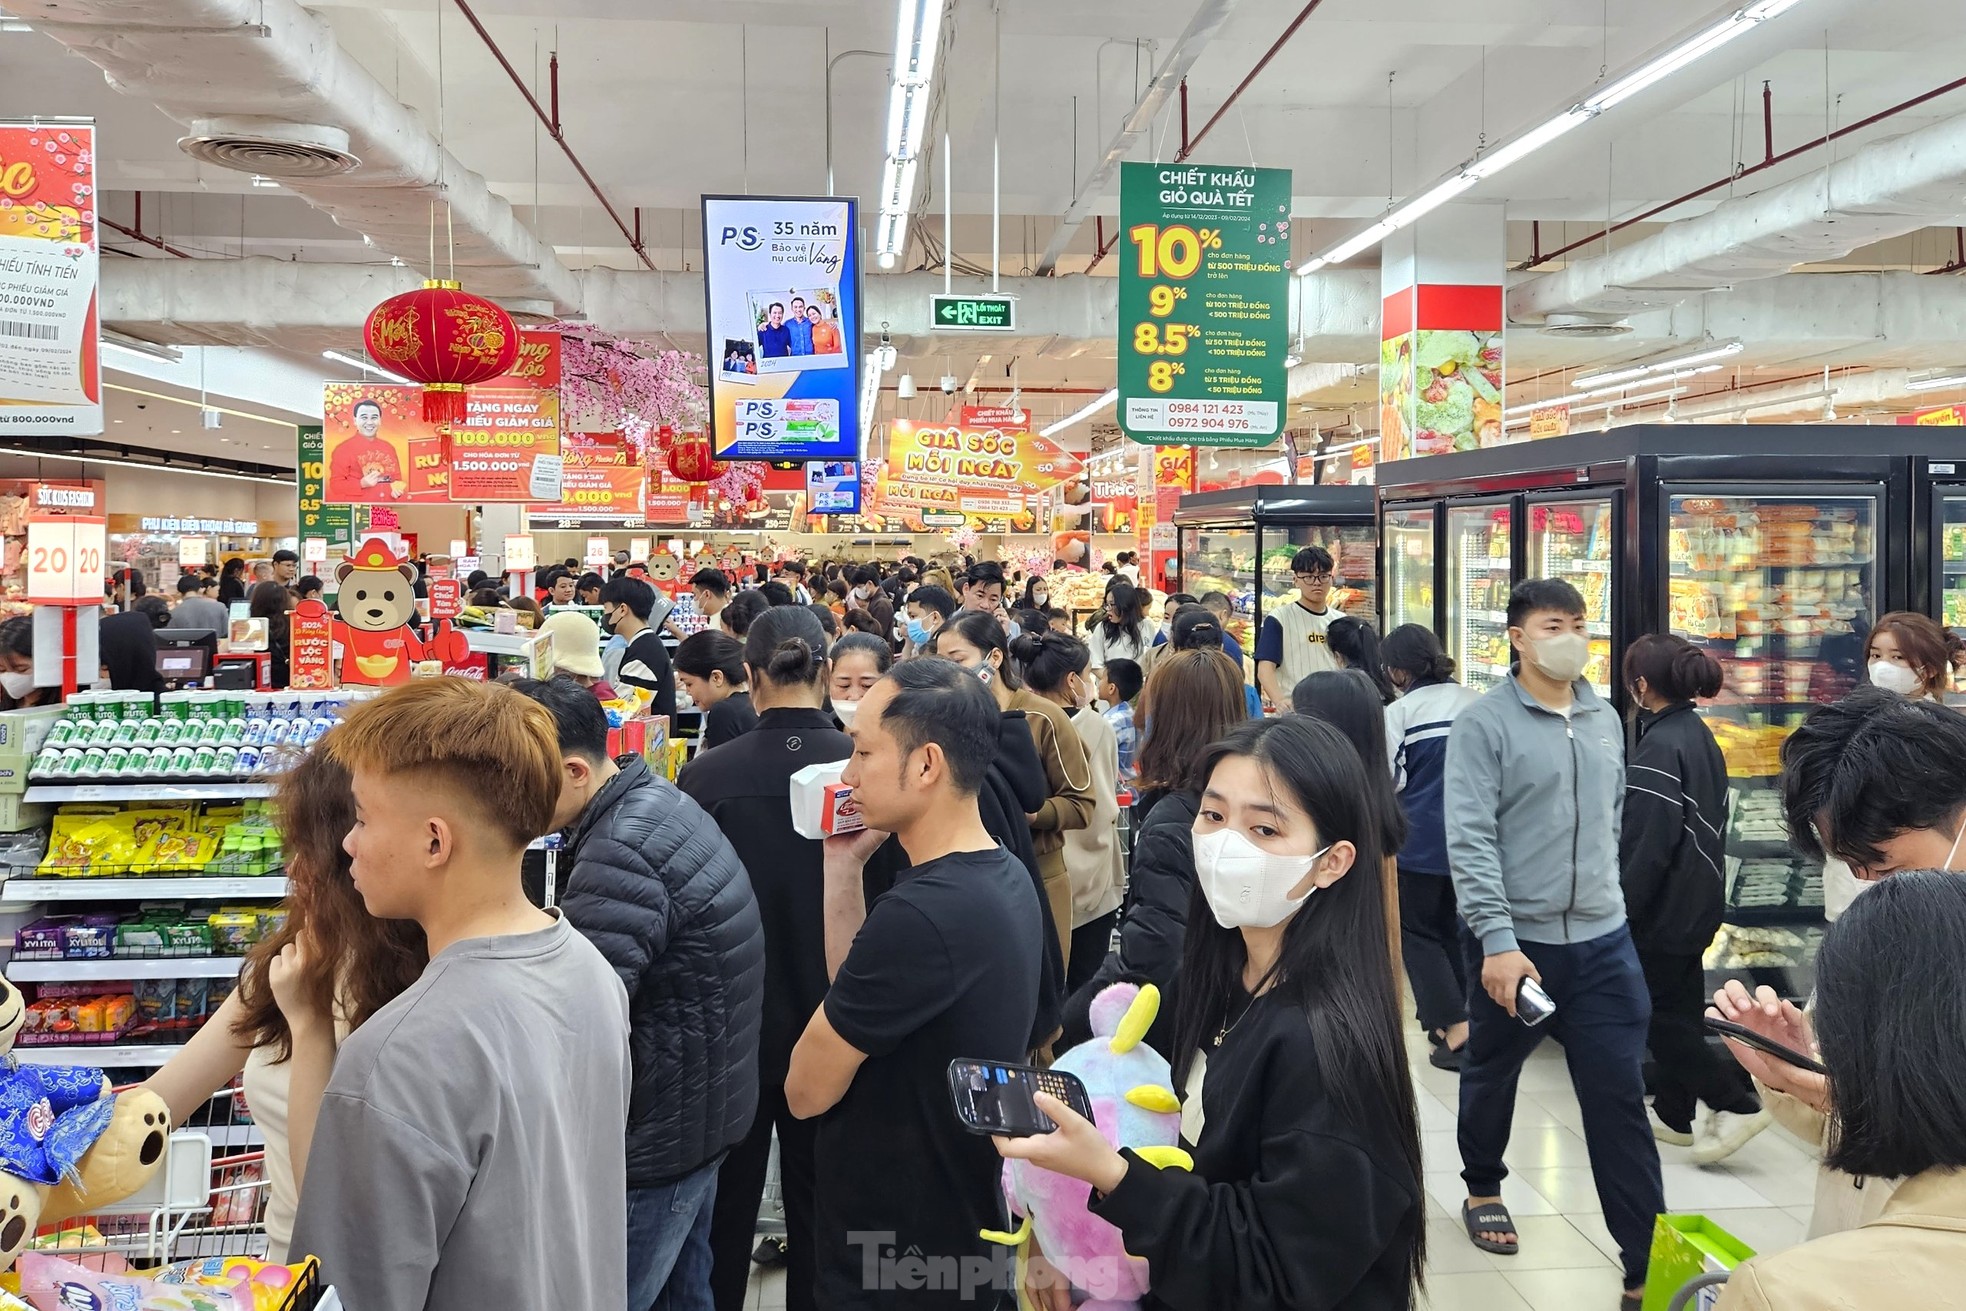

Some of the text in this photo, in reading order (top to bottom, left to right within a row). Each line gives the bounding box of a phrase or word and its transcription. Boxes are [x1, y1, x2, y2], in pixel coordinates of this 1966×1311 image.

[1160, 168, 1255, 187] CHIẾT KHẤU
[1160, 186, 1254, 206] GIỎ QUÀ TẾT
[774, 221, 837, 235] 35 năm
[772, 241, 841, 274] Bảo vệ Vàng
[1130, 224, 1222, 279] 10%
[772, 254, 807, 264] nụ cười
[26, 260, 52, 277] TÍNH
[1233, 262, 1257, 272] TRIỆU
[1257, 262, 1281, 272] ĐỒNG
[8, 282, 32, 293] PHIẾU
[34, 284, 54, 296] GIẢM
[55, 287, 69, 297] GIÁ
[0, 294, 54, 308] 00.000VND
[1148, 284, 1187, 317] 9%
[1228, 301, 1248, 309] TRIỆU
[1249, 300, 1270, 309] ĐỒNG
[979, 316, 1003, 324] EXIT
[1228, 310, 1248, 319] TRIỆU
[1249, 310, 1270, 319] ĐỒNG
[1133, 321, 1201, 356] 8.5%
[1224, 338, 1244, 347] TRIỆU
[1245, 338, 1266, 347] ĐỒNG
[1226, 348, 1245, 357] TRIỆU
[1246, 348, 1266, 357] ĐỒNG
[512, 357, 546, 377] Lộc
[1148, 360, 1185, 393] 8%
[1219, 376, 1239, 384] TRIỆU
[1241, 376, 1262, 384] ĐỒNG
[1222, 386, 1241, 394] TRIỆU
[1242, 386, 1262, 394] ĐỒNG
[466, 402, 539, 415] TẶNG NGAY
[1168, 403, 1199, 414] 0984
[1202, 404, 1219, 414] 121
[1222, 404, 1244, 415] 423
[12, 415, 75, 423] 800.000vnd
[495, 416, 555, 428] GIẢM GIÁ
[1168, 417, 1198, 428] 0972
[1201, 418, 1224, 428] 904
[1228, 418, 1249, 429] 976
[454, 431, 535, 447] 100.000
[918, 430, 1016, 454] GIÁ SỐC
[414, 454, 441, 468] RƯ
[453, 461, 518, 471] 1.500.000
[907, 450, 1022, 479] MỖI NGÀY
[1159, 456, 1190, 473] GIÁ
[592, 548, 603, 556] 26
[34, 547, 67, 573] 20
[80, 547, 99, 573] 20
[433, 584, 454, 593] Cung
[433, 591, 454, 599] Chúc
[433, 607, 455, 615] Xuân
[301, 621, 323, 629] 2024
[294, 638, 328, 647] RƯỚC
[1308, 632, 1326, 643] dre
[301, 647, 322, 656] LỘC
[298, 655, 325, 665] VÀNG
[69, 938, 103, 946] XYLITOL
